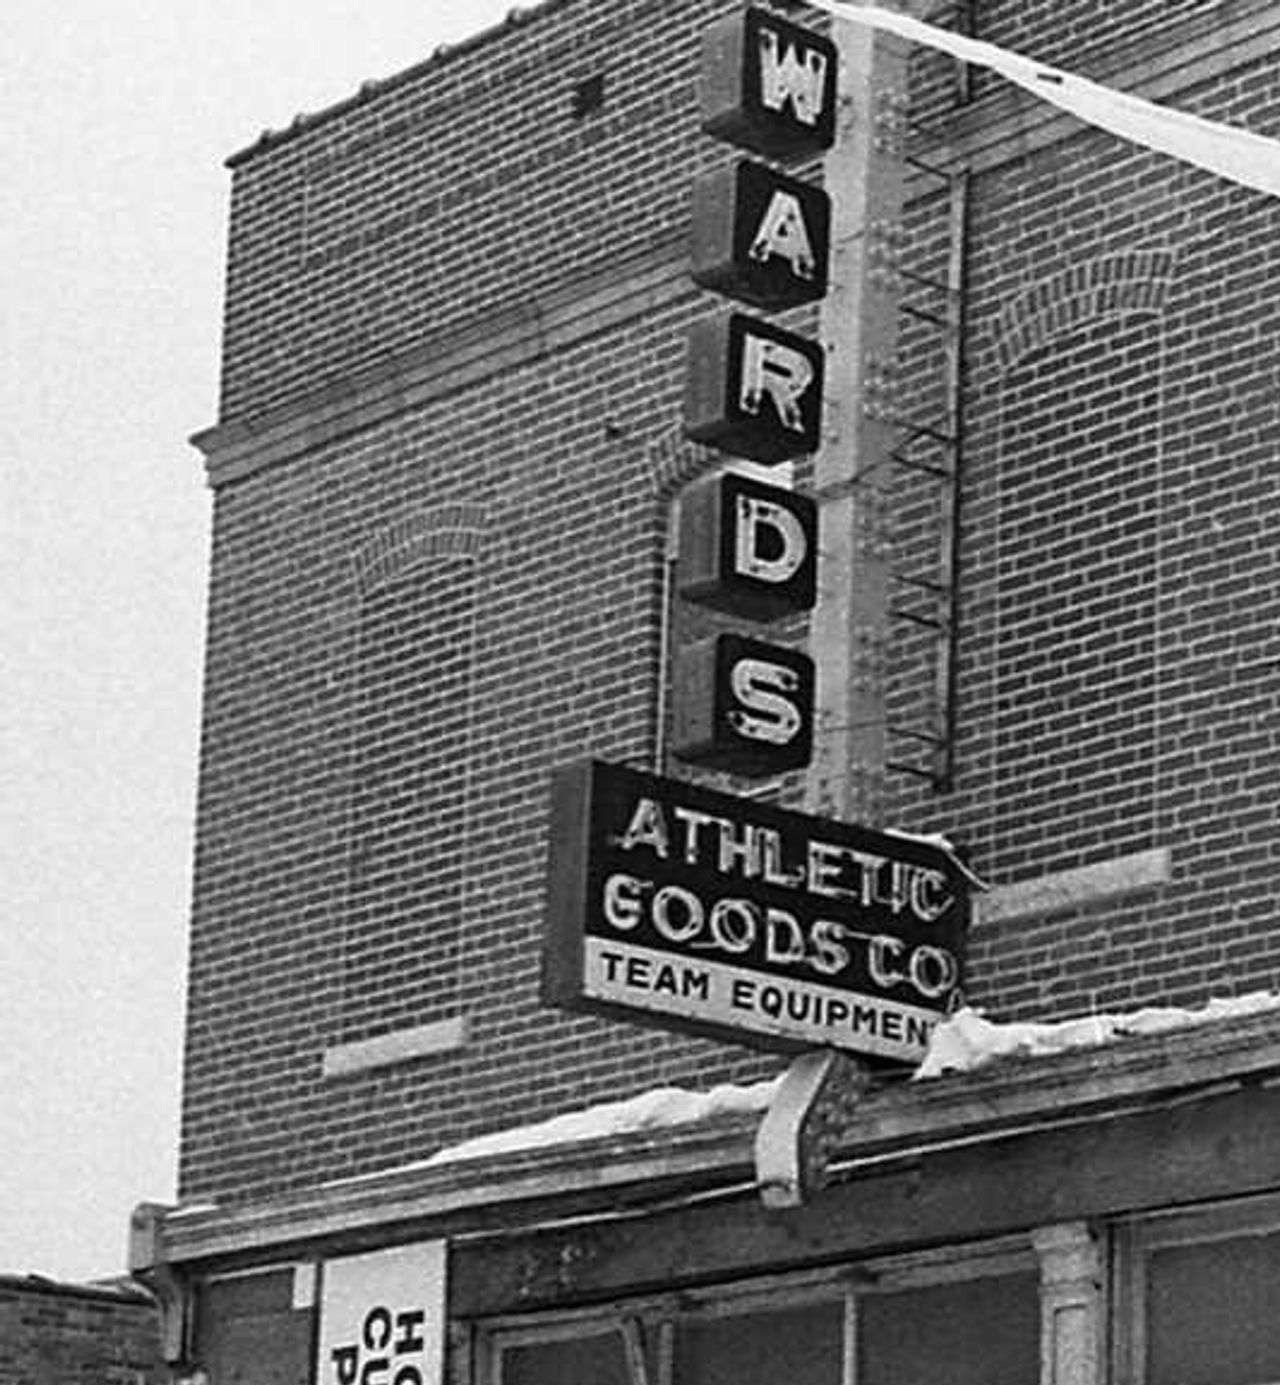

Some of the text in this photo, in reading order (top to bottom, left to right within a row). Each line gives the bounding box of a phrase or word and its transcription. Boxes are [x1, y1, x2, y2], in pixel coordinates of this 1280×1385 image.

[727, 27, 827, 747] WARDS
[612, 799, 955, 921] ATHLETIC
[603, 873, 850, 974] GOODS
[600, 951, 936, 1048] TEAM EQUIPMEN
